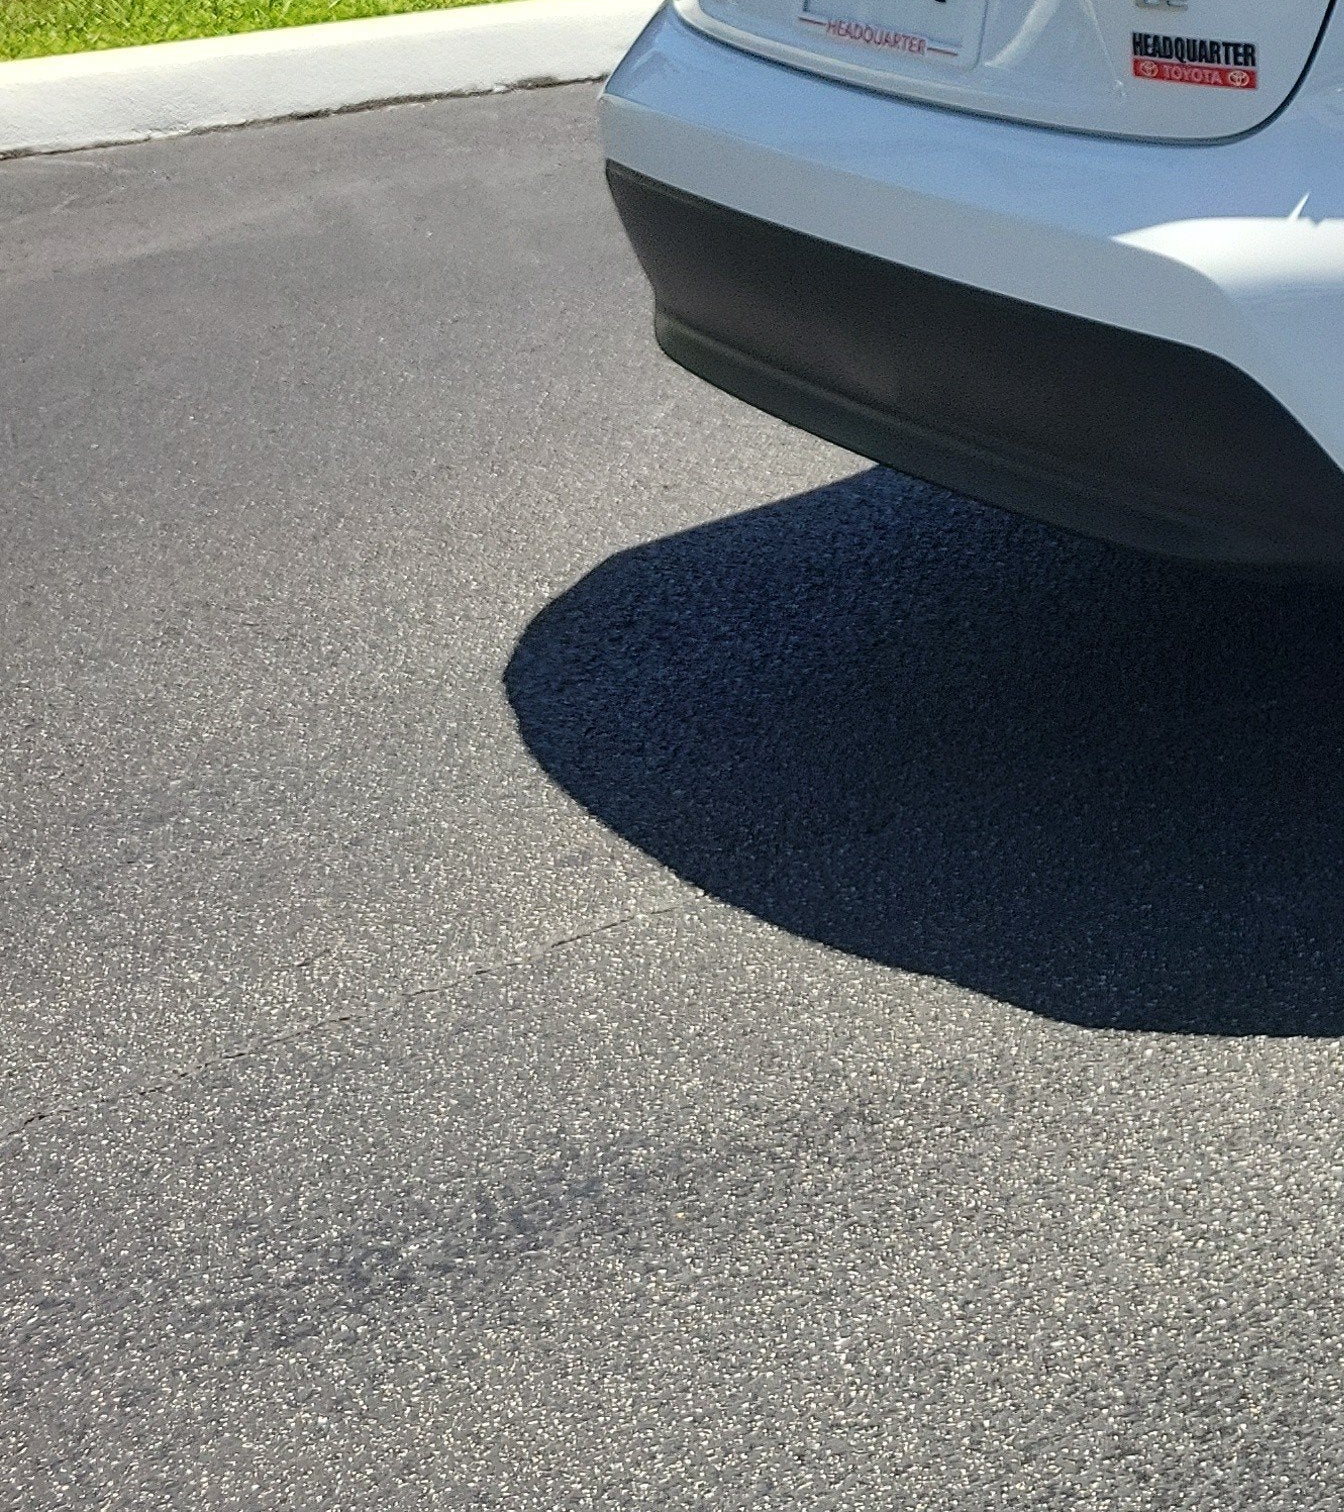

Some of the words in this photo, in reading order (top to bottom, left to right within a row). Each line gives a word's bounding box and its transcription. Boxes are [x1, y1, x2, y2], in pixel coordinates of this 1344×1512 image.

[826, 20, 927, 55] HEADQUARTER
[1132, 31, 1256, 67] HEADQUARTER
[1162, 65, 1223, 84] TOYOTA
